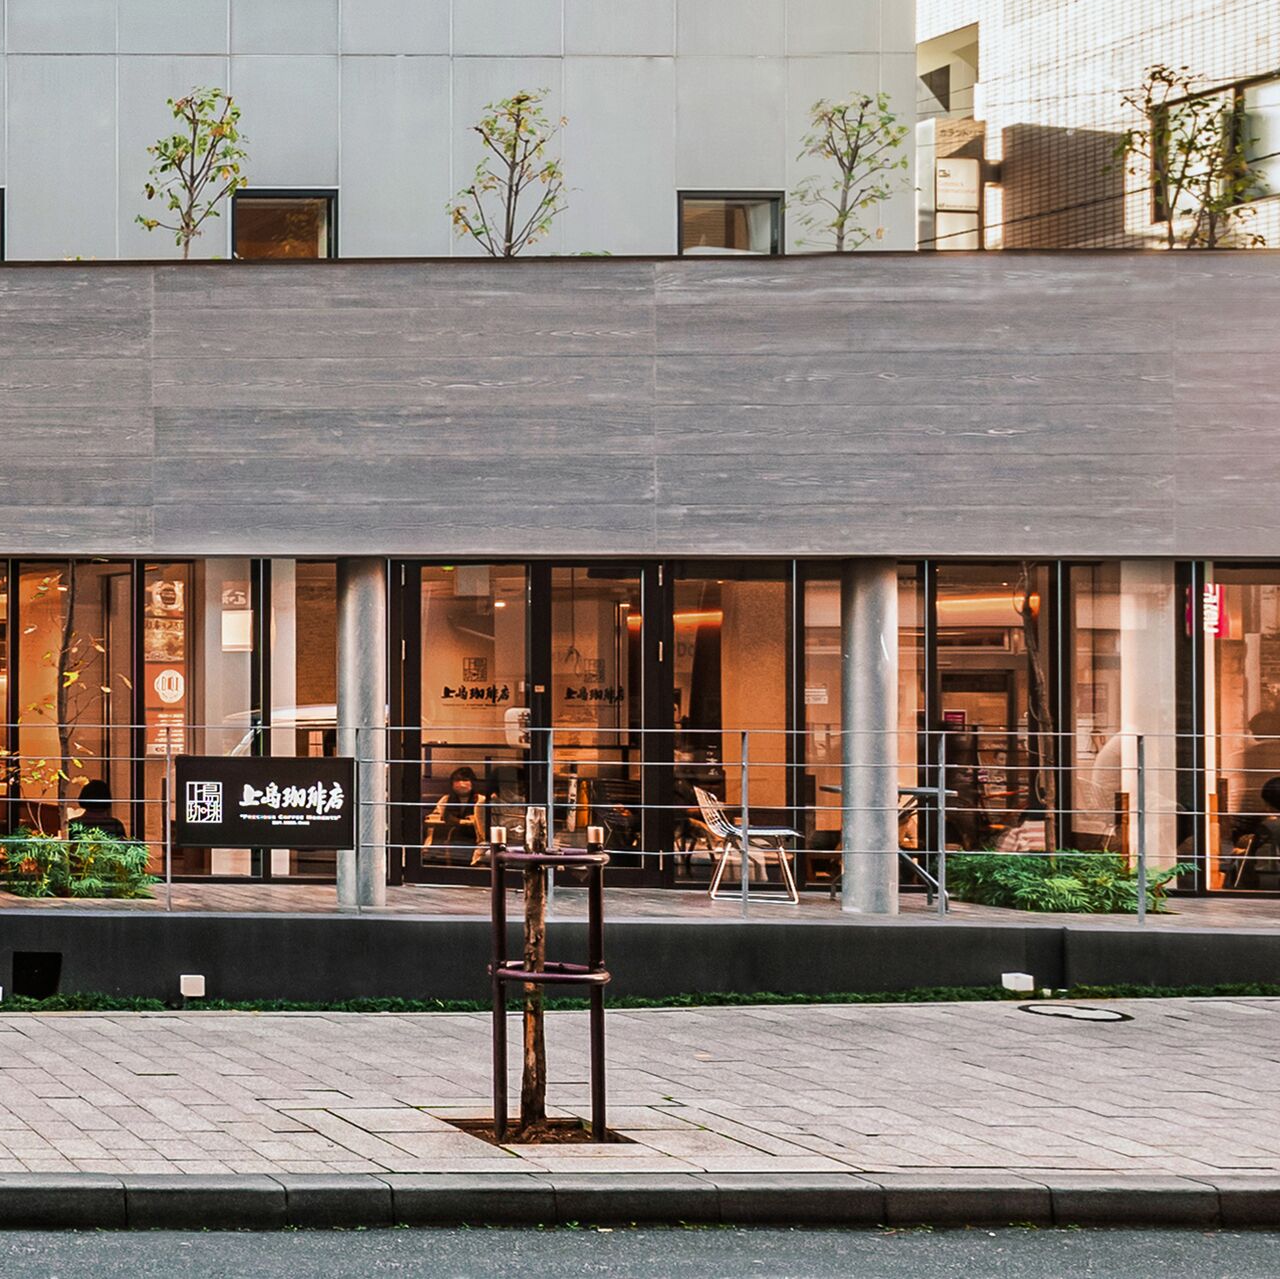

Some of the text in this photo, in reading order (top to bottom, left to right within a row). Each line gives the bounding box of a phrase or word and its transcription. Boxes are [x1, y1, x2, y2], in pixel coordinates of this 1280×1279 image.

[441, 684, 510, 703] 上島珈琲店
[239, 781, 345, 815] 上島珈琲店
